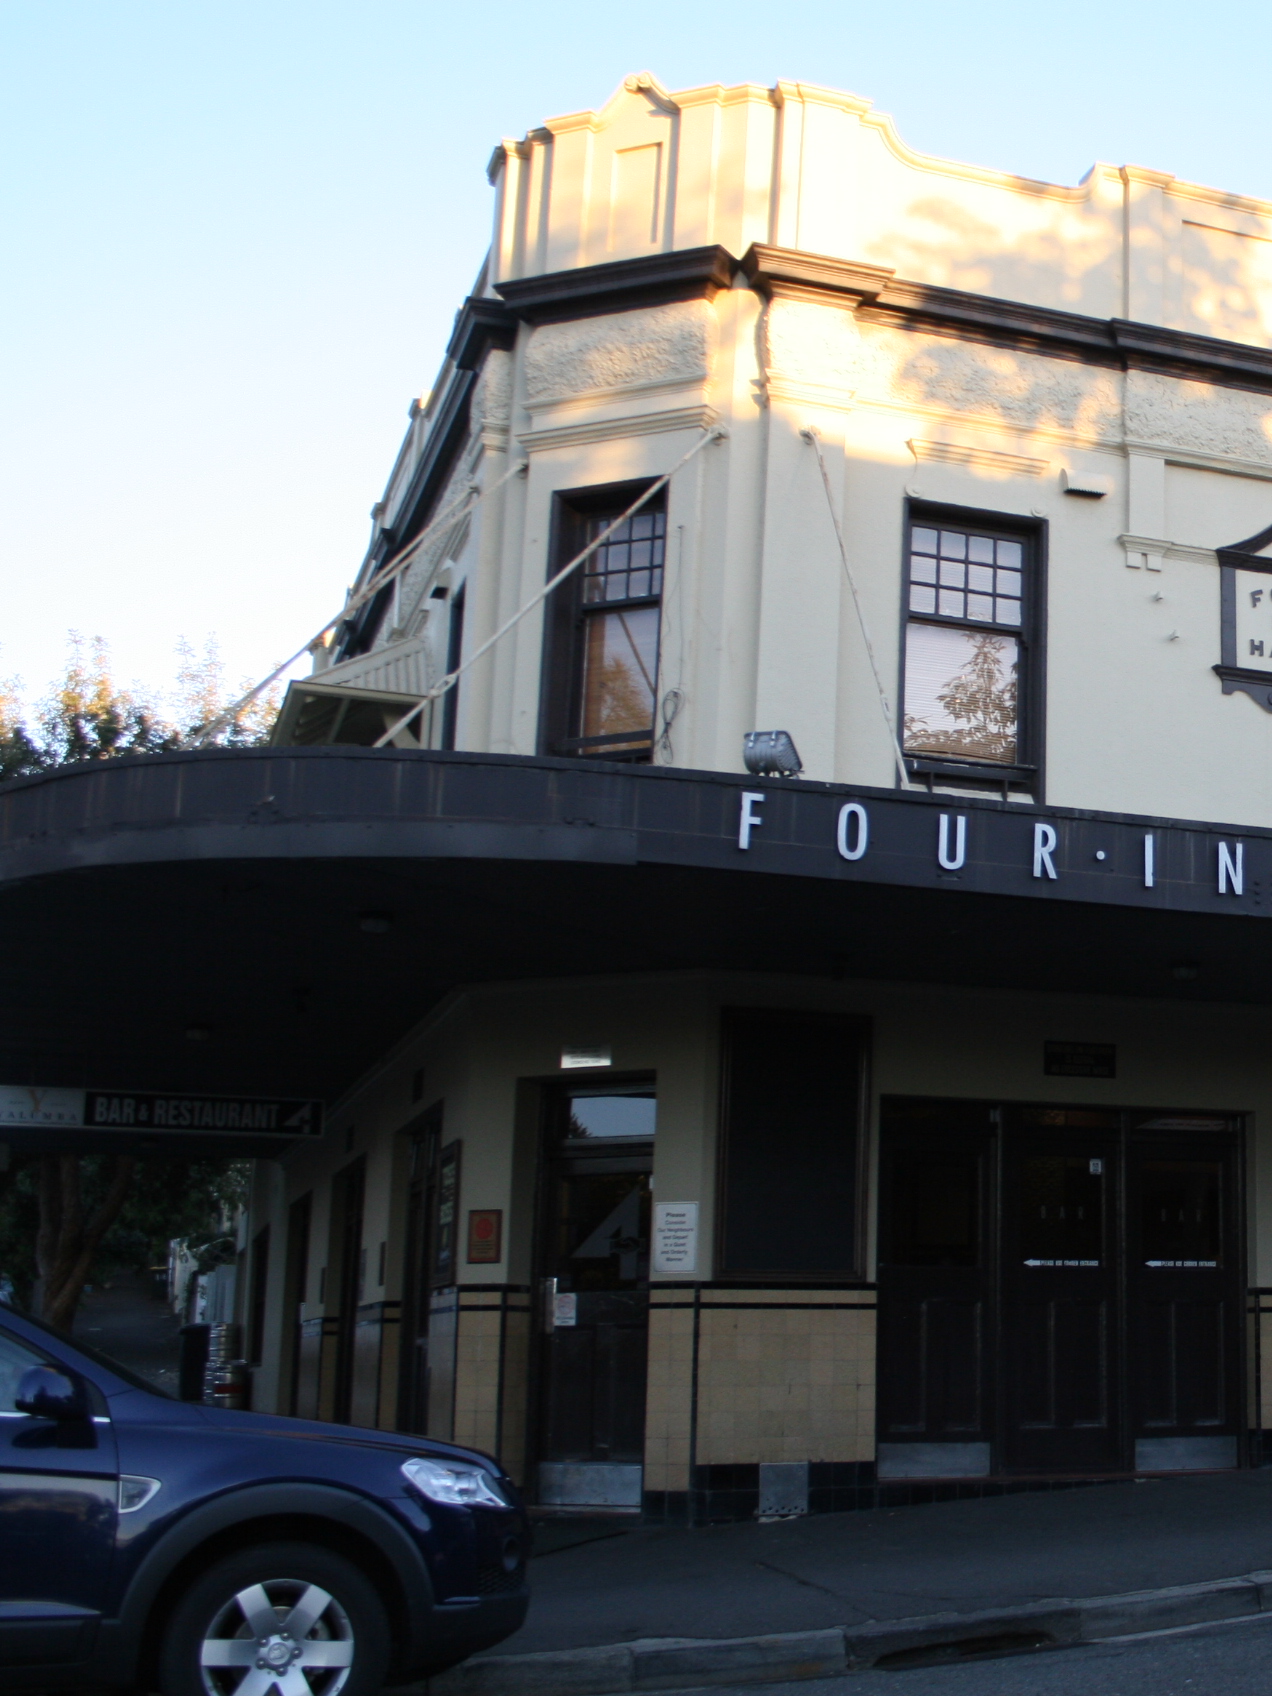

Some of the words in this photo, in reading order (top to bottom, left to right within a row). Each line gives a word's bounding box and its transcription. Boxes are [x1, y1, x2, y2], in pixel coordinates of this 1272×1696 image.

[738, 791, 1058, 881] FOUR
[95, 1096, 136, 1124] BAR
[138, 1103, 150, 1122] &
[154, 1099, 280, 1128] RESTAURANT
